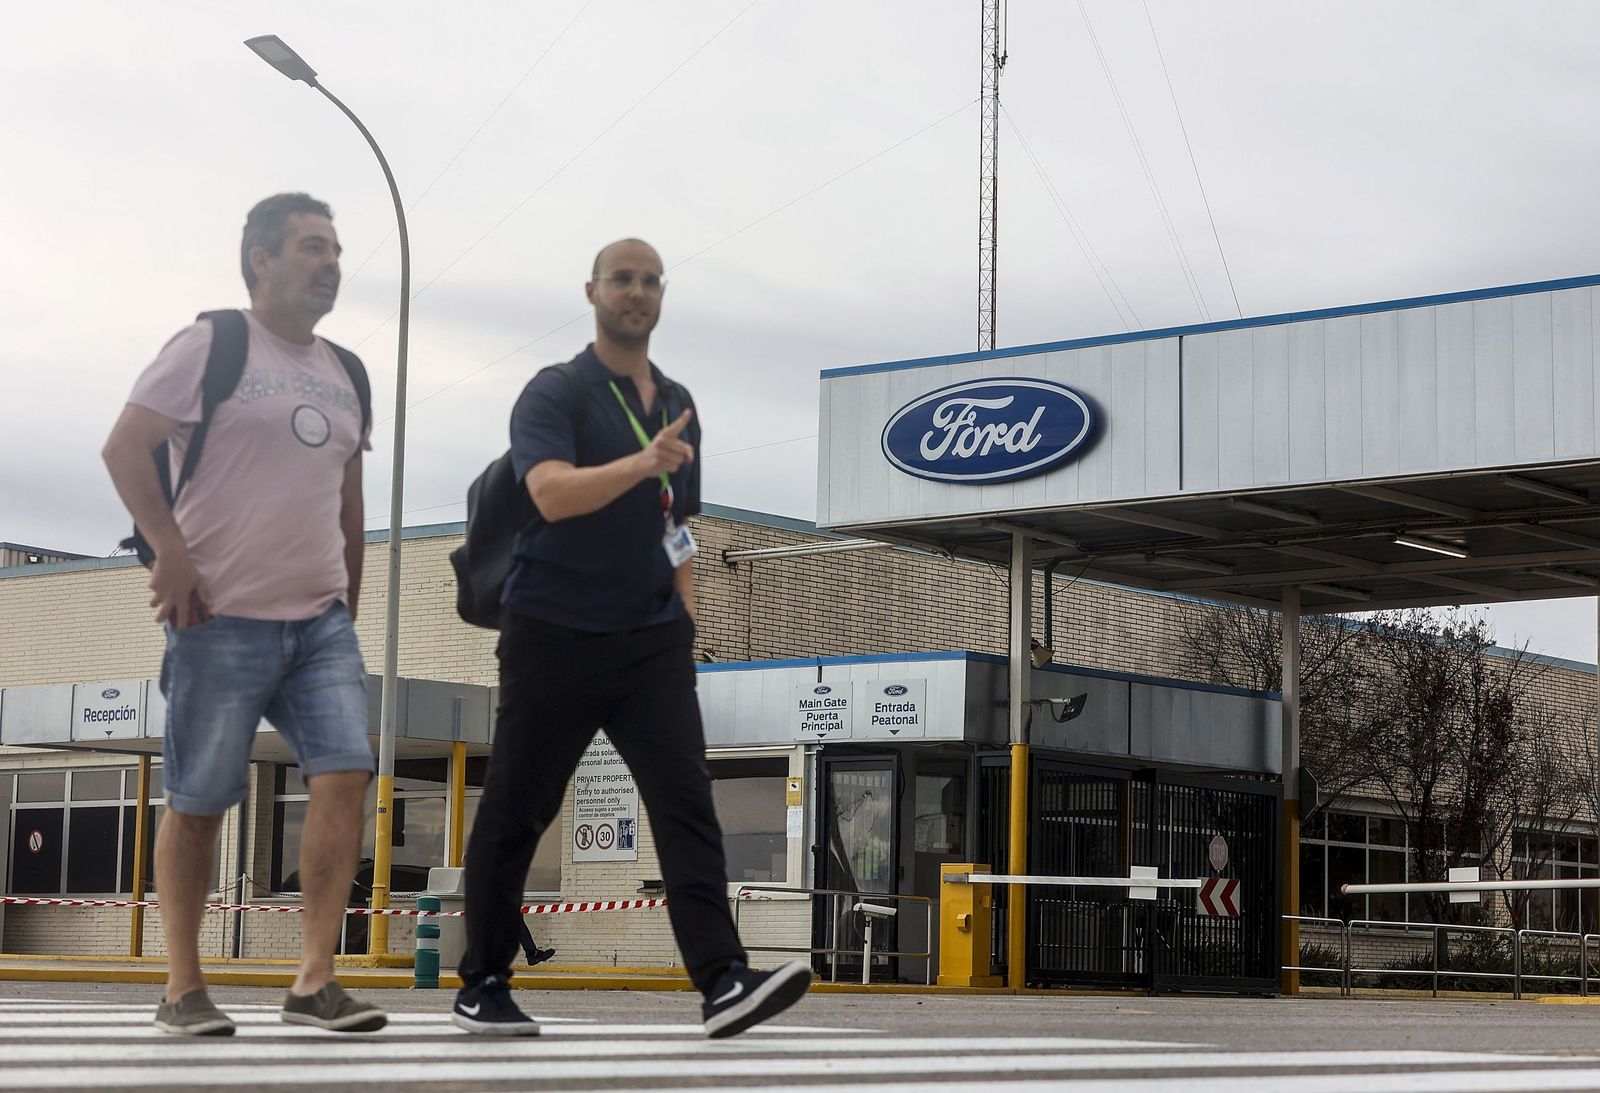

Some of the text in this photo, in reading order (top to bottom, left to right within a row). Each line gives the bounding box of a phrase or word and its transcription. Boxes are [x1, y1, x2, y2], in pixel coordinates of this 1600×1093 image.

[920, 395, 1045, 461] Ford
[799, 698, 847, 708] Main Gate
[875, 701, 916, 712] Entrada
[84, 705, 136, 724] Recepción
[807, 712, 838, 721] Puerta
[872, 714, 918, 725] Peatonal
[801, 720, 843, 731] Principal
[577, 759, 602, 768] personal
[577, 788, 593, 796] Entry
[601, 786, 634, 794] authorised
[577, 797, 621, 805] personnel only
[600, 831, 611, 842] 30
